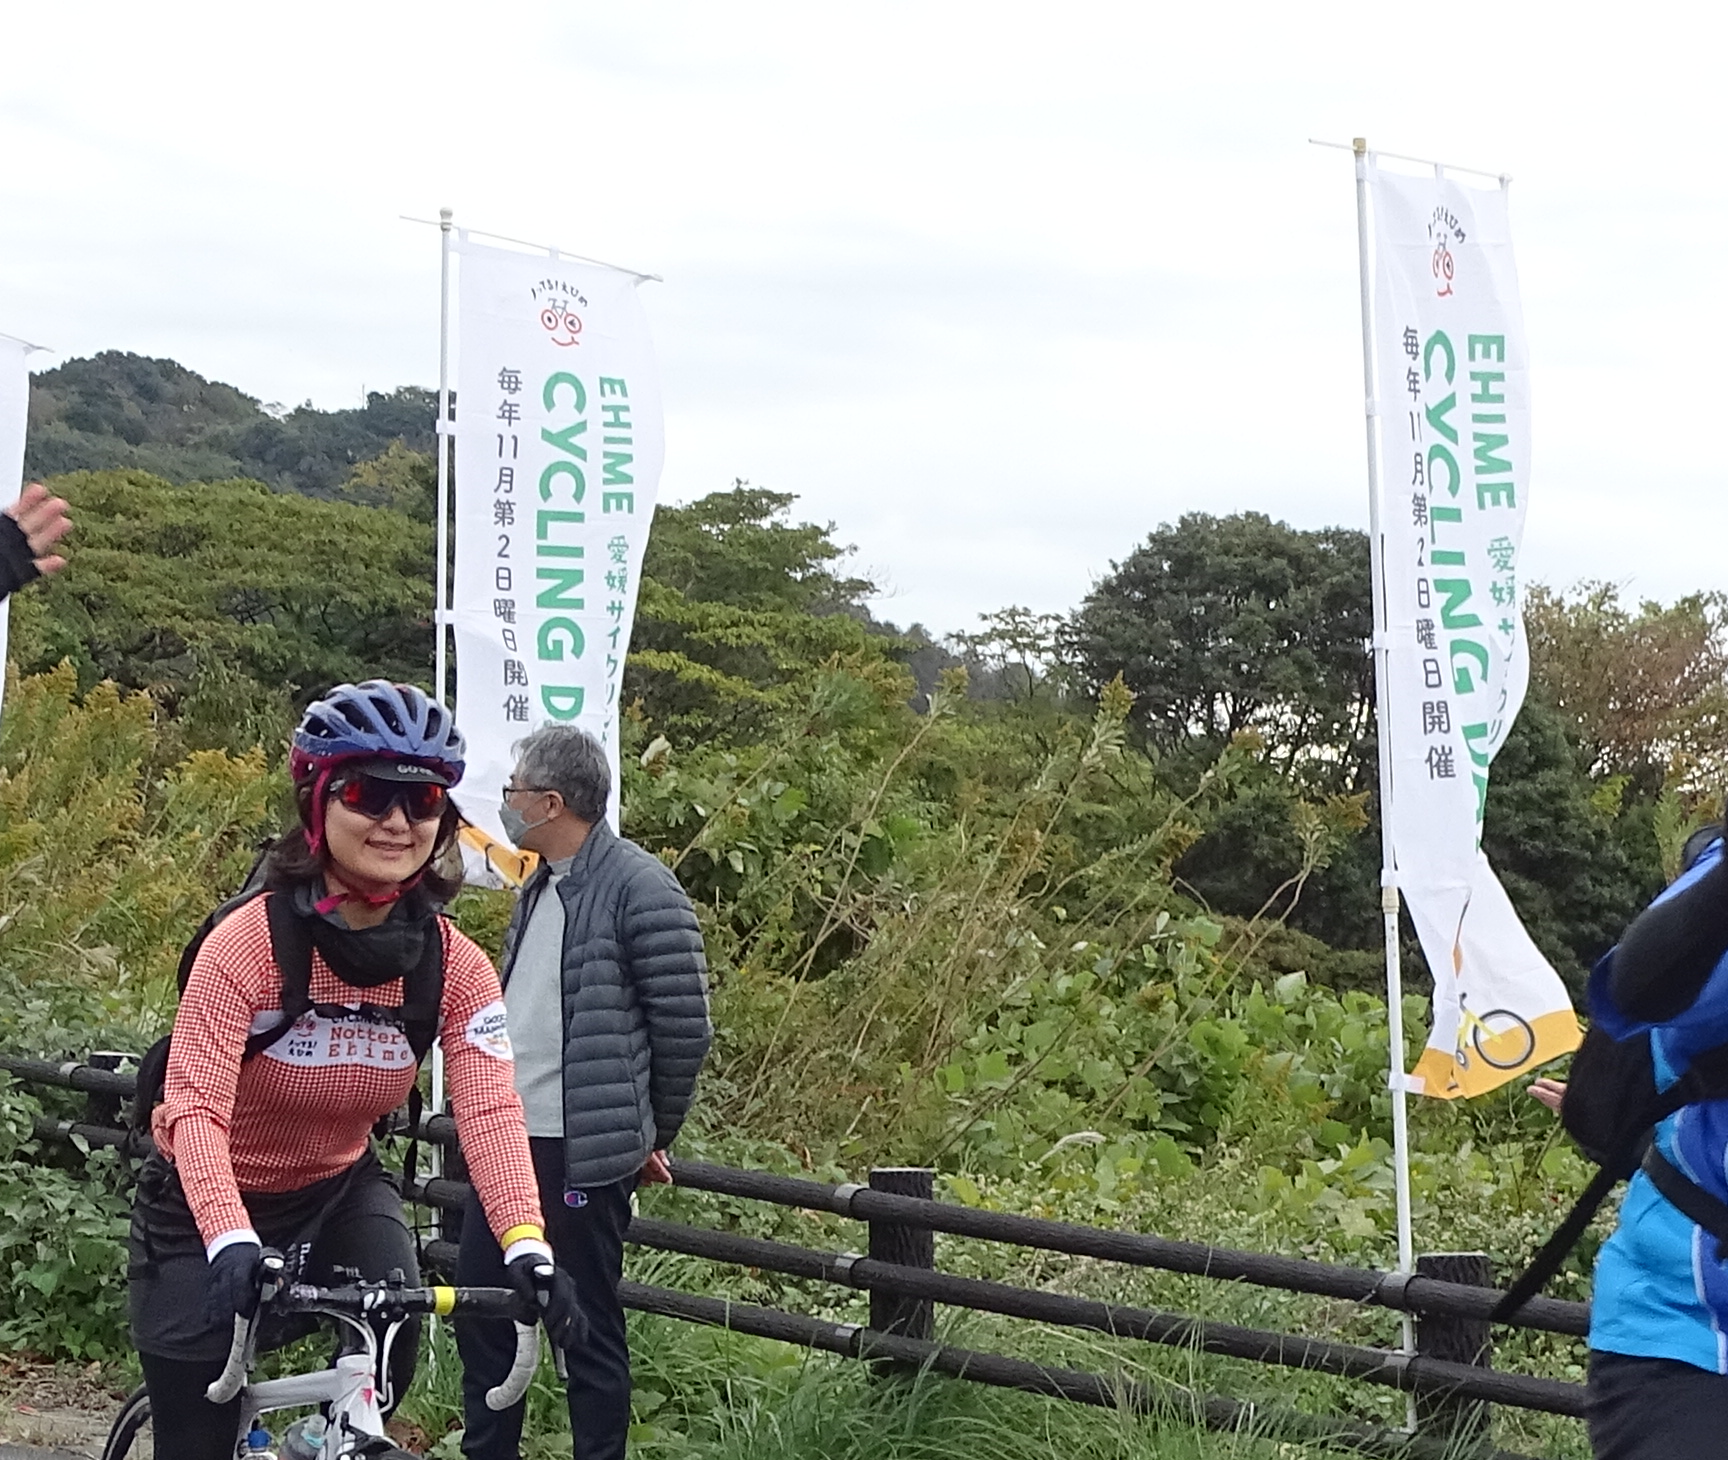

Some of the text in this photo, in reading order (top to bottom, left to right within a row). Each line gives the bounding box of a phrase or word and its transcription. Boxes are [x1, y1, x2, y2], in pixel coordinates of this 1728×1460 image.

[493, 366, 529, 723] 毎年11月第2日曜日開催
[535, 371, 589, 663] CYCLING
[598, 376, 634, 515] EHIME
[1403, 325, 1457, 781] 毎年11月第2日曜日開催
[1424, 329, 1490, 695] CYCLING
[1468, 334, 1517, 511] EHIME
[328, 1041, 408, 1061] Ehime
